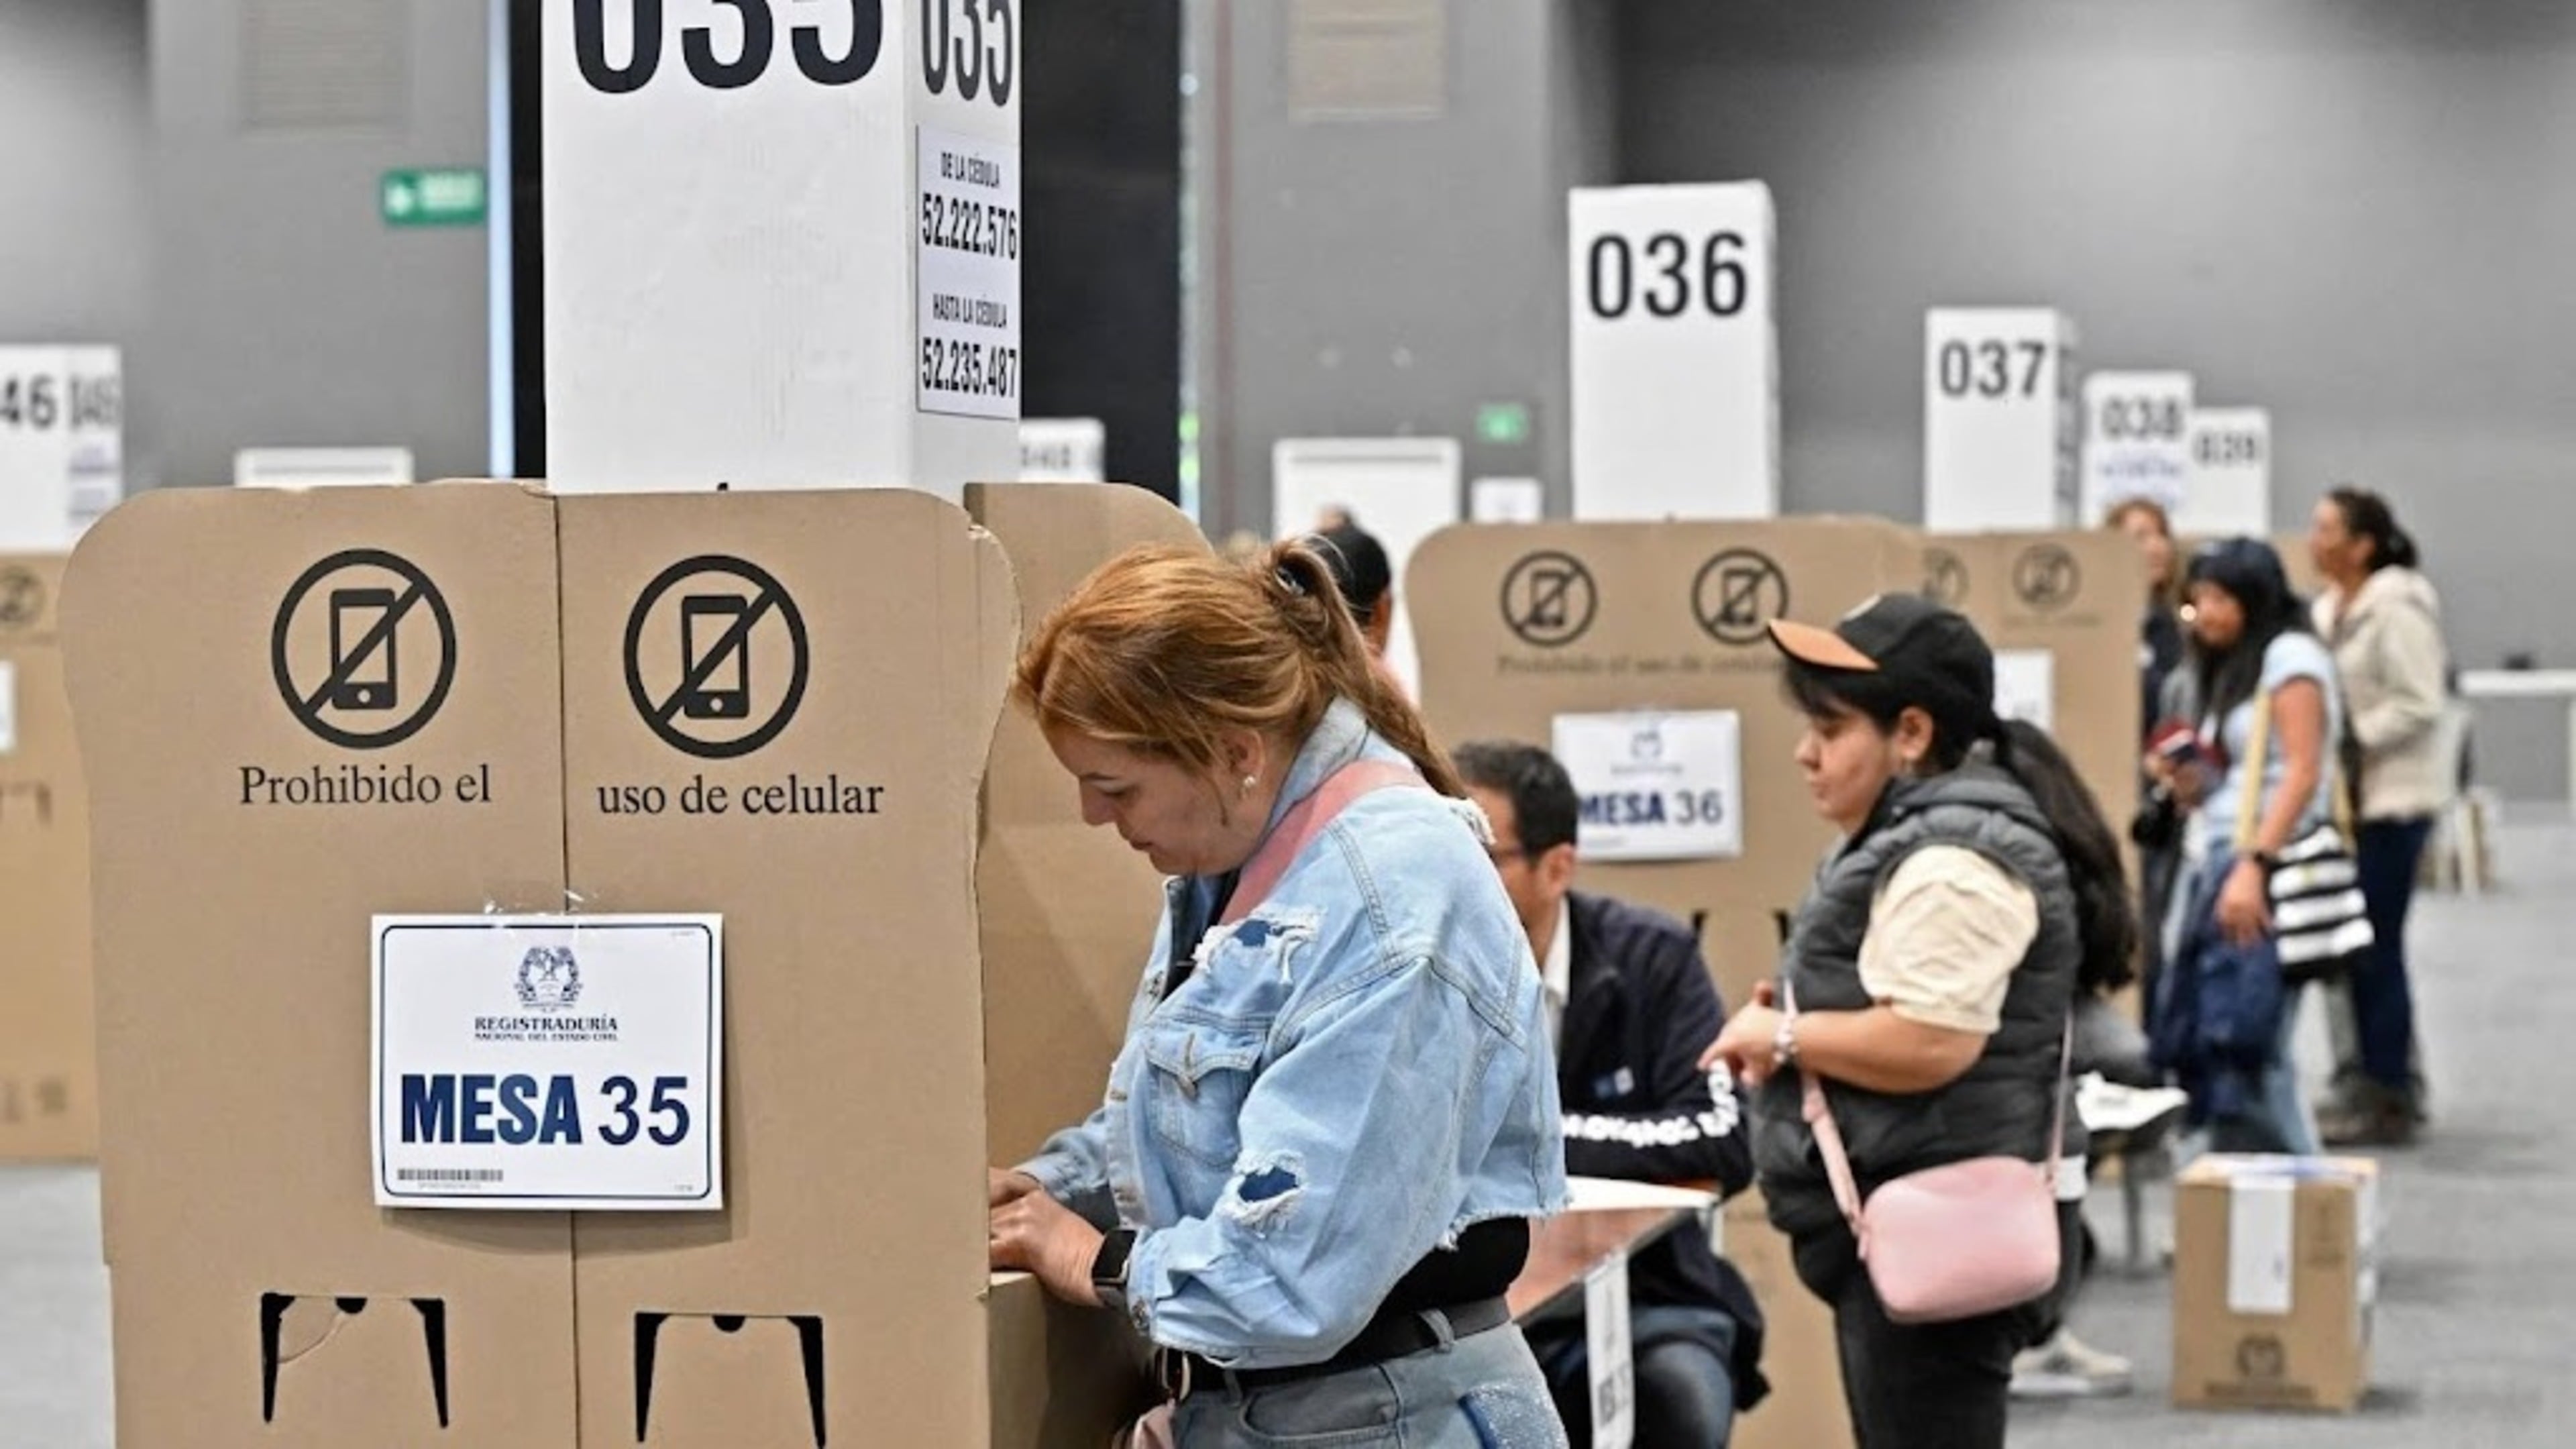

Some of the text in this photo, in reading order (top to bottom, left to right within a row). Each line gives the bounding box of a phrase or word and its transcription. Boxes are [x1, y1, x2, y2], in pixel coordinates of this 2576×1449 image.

[573, 0, 883, 93] 035
[922, 0, 1012, 107] 035
[941, 150, 1000, 189] DE LA CÉDULA
[922, 191, 1017, 260] 52.222.576
[1587, 231, 1747, 318] 036
[933, 292, 1007, 328] HASTA LA CÉDULA
[922, 335, 1017, 398] 52.235.487
[1940, 340, 2046, 397] 037
[240, 763, 491, 805] Prohibido el
[597, 774, 883, 814] uso de celular
[1578, 788, 1723, 825] MESA 36
[474, 1013, 619, 1031] REGISTRADURÍA
[401, 1074, 690, 1146] MESA 35
